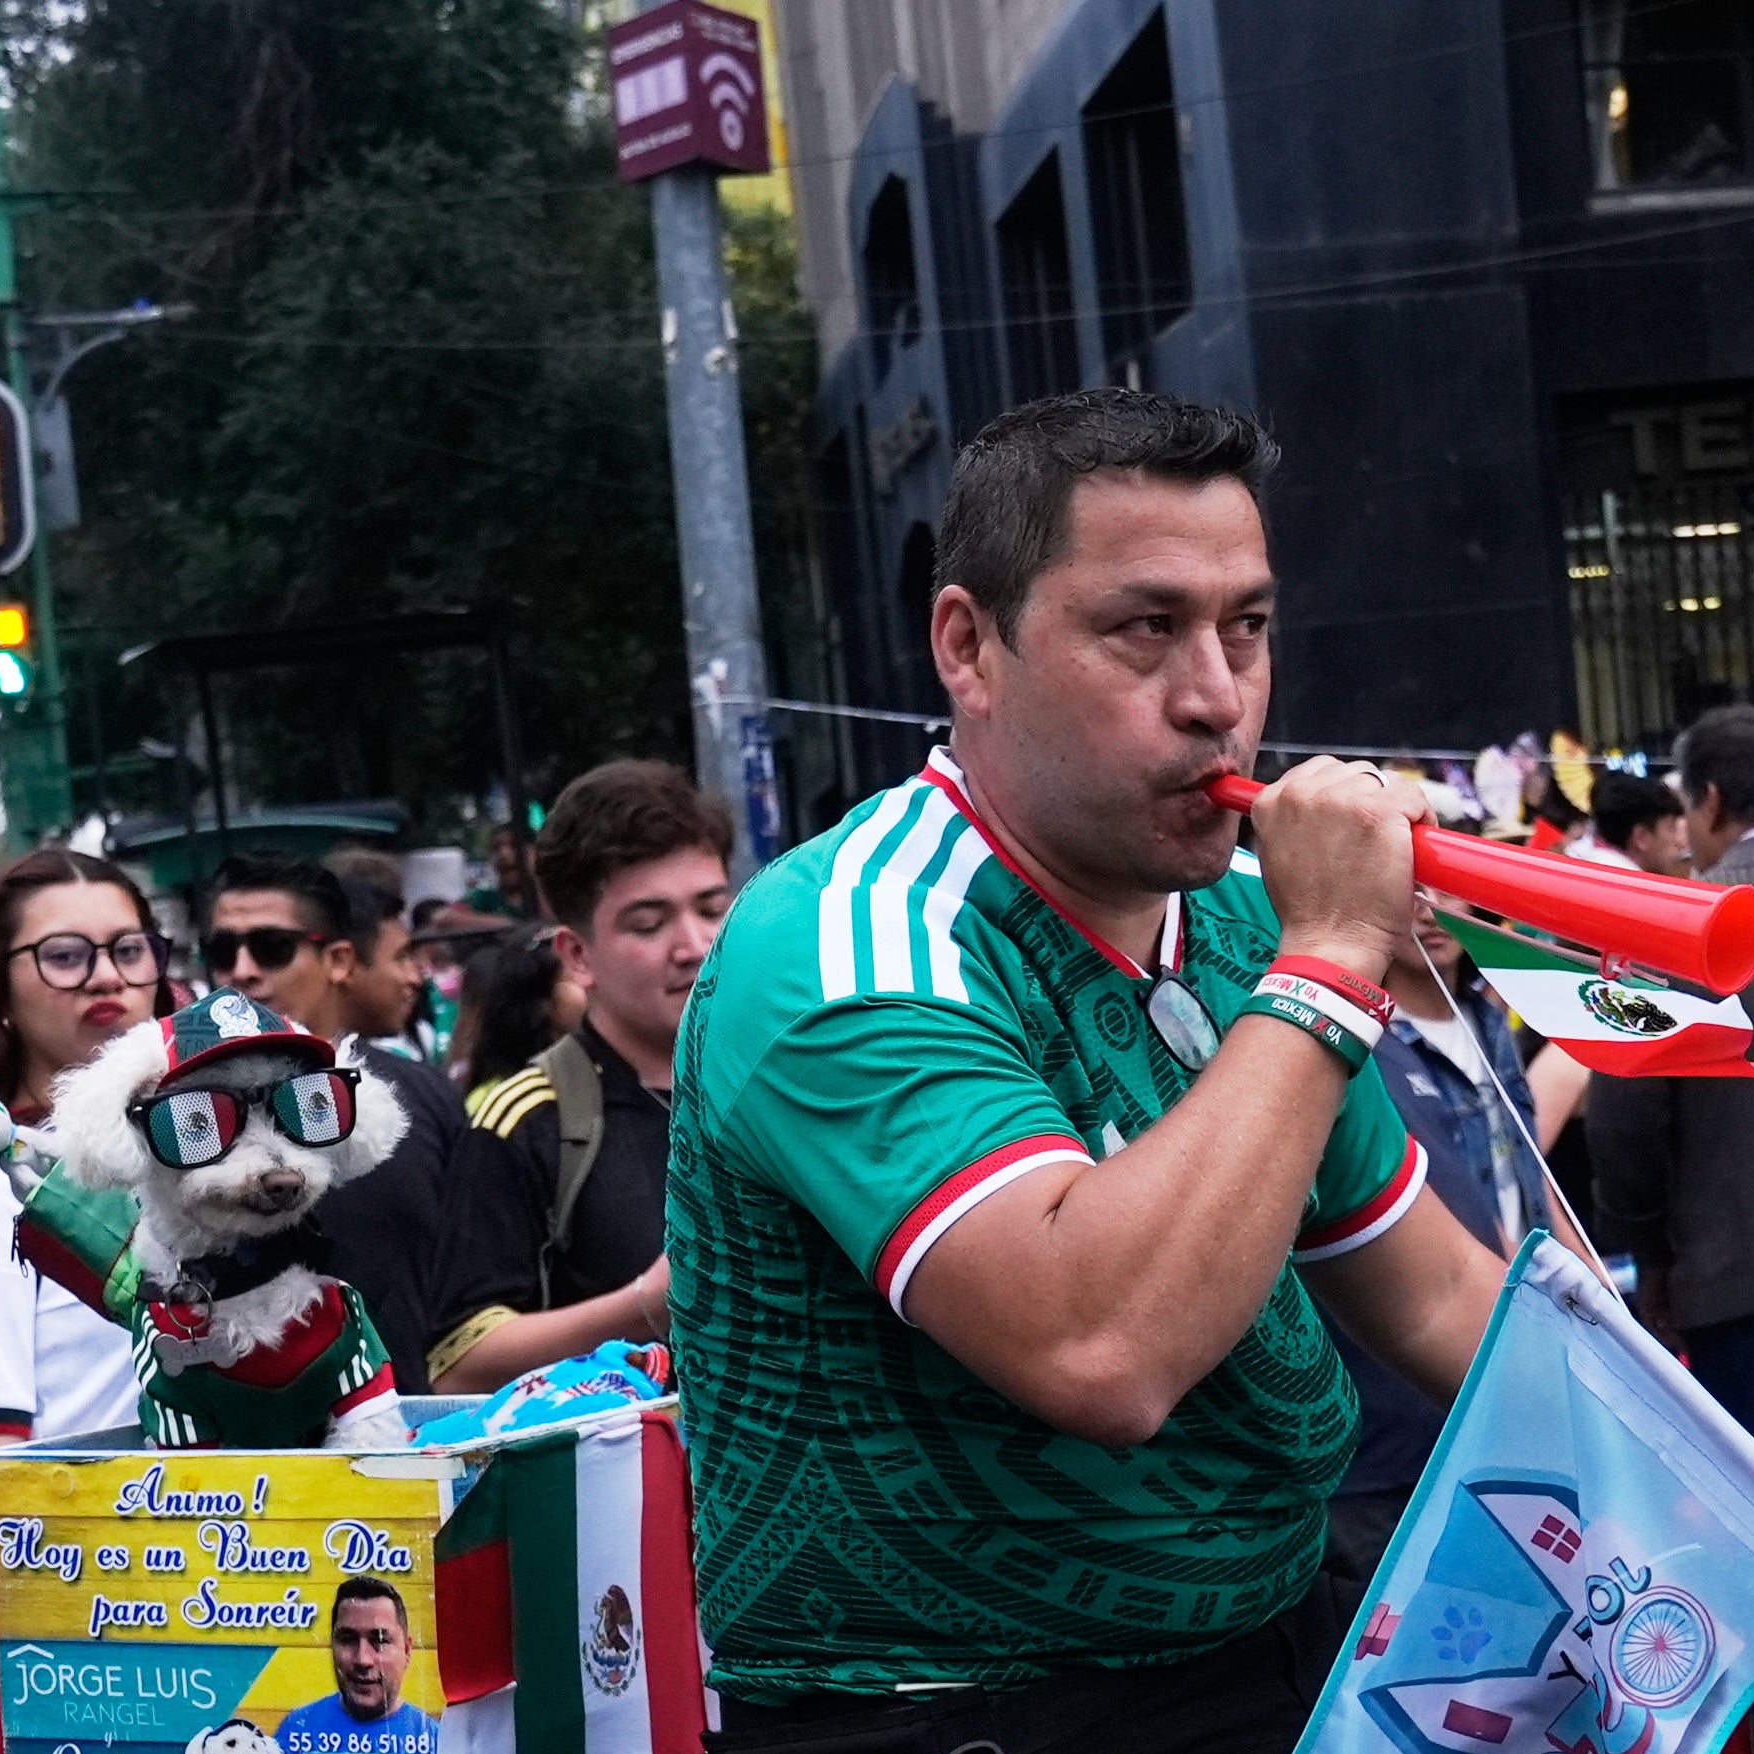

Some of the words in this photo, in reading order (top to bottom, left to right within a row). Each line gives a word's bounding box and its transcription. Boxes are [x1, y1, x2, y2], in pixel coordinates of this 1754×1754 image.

[98, 1544, 129, 1569] es
[145, 1545, 185, 1570] un
[200, 1521, 310, 1572] Buen
[325, 1520, 411, 1571] Día
[90, 1596, 167, 1635] para
[182, 1579, 317, 1628] Sonreír
[136, 1666, 217, 1710] LUIS
[64, 1701, 166, 1727] RANGEL
[289, 1732, 313, 1752] 55
[318, 1732, 342, 1753] 39
[348, 1733, 372, 1753] 86
[379, 1734, 398, 1754] 51
[404, 1733, 431, 1754] 88
